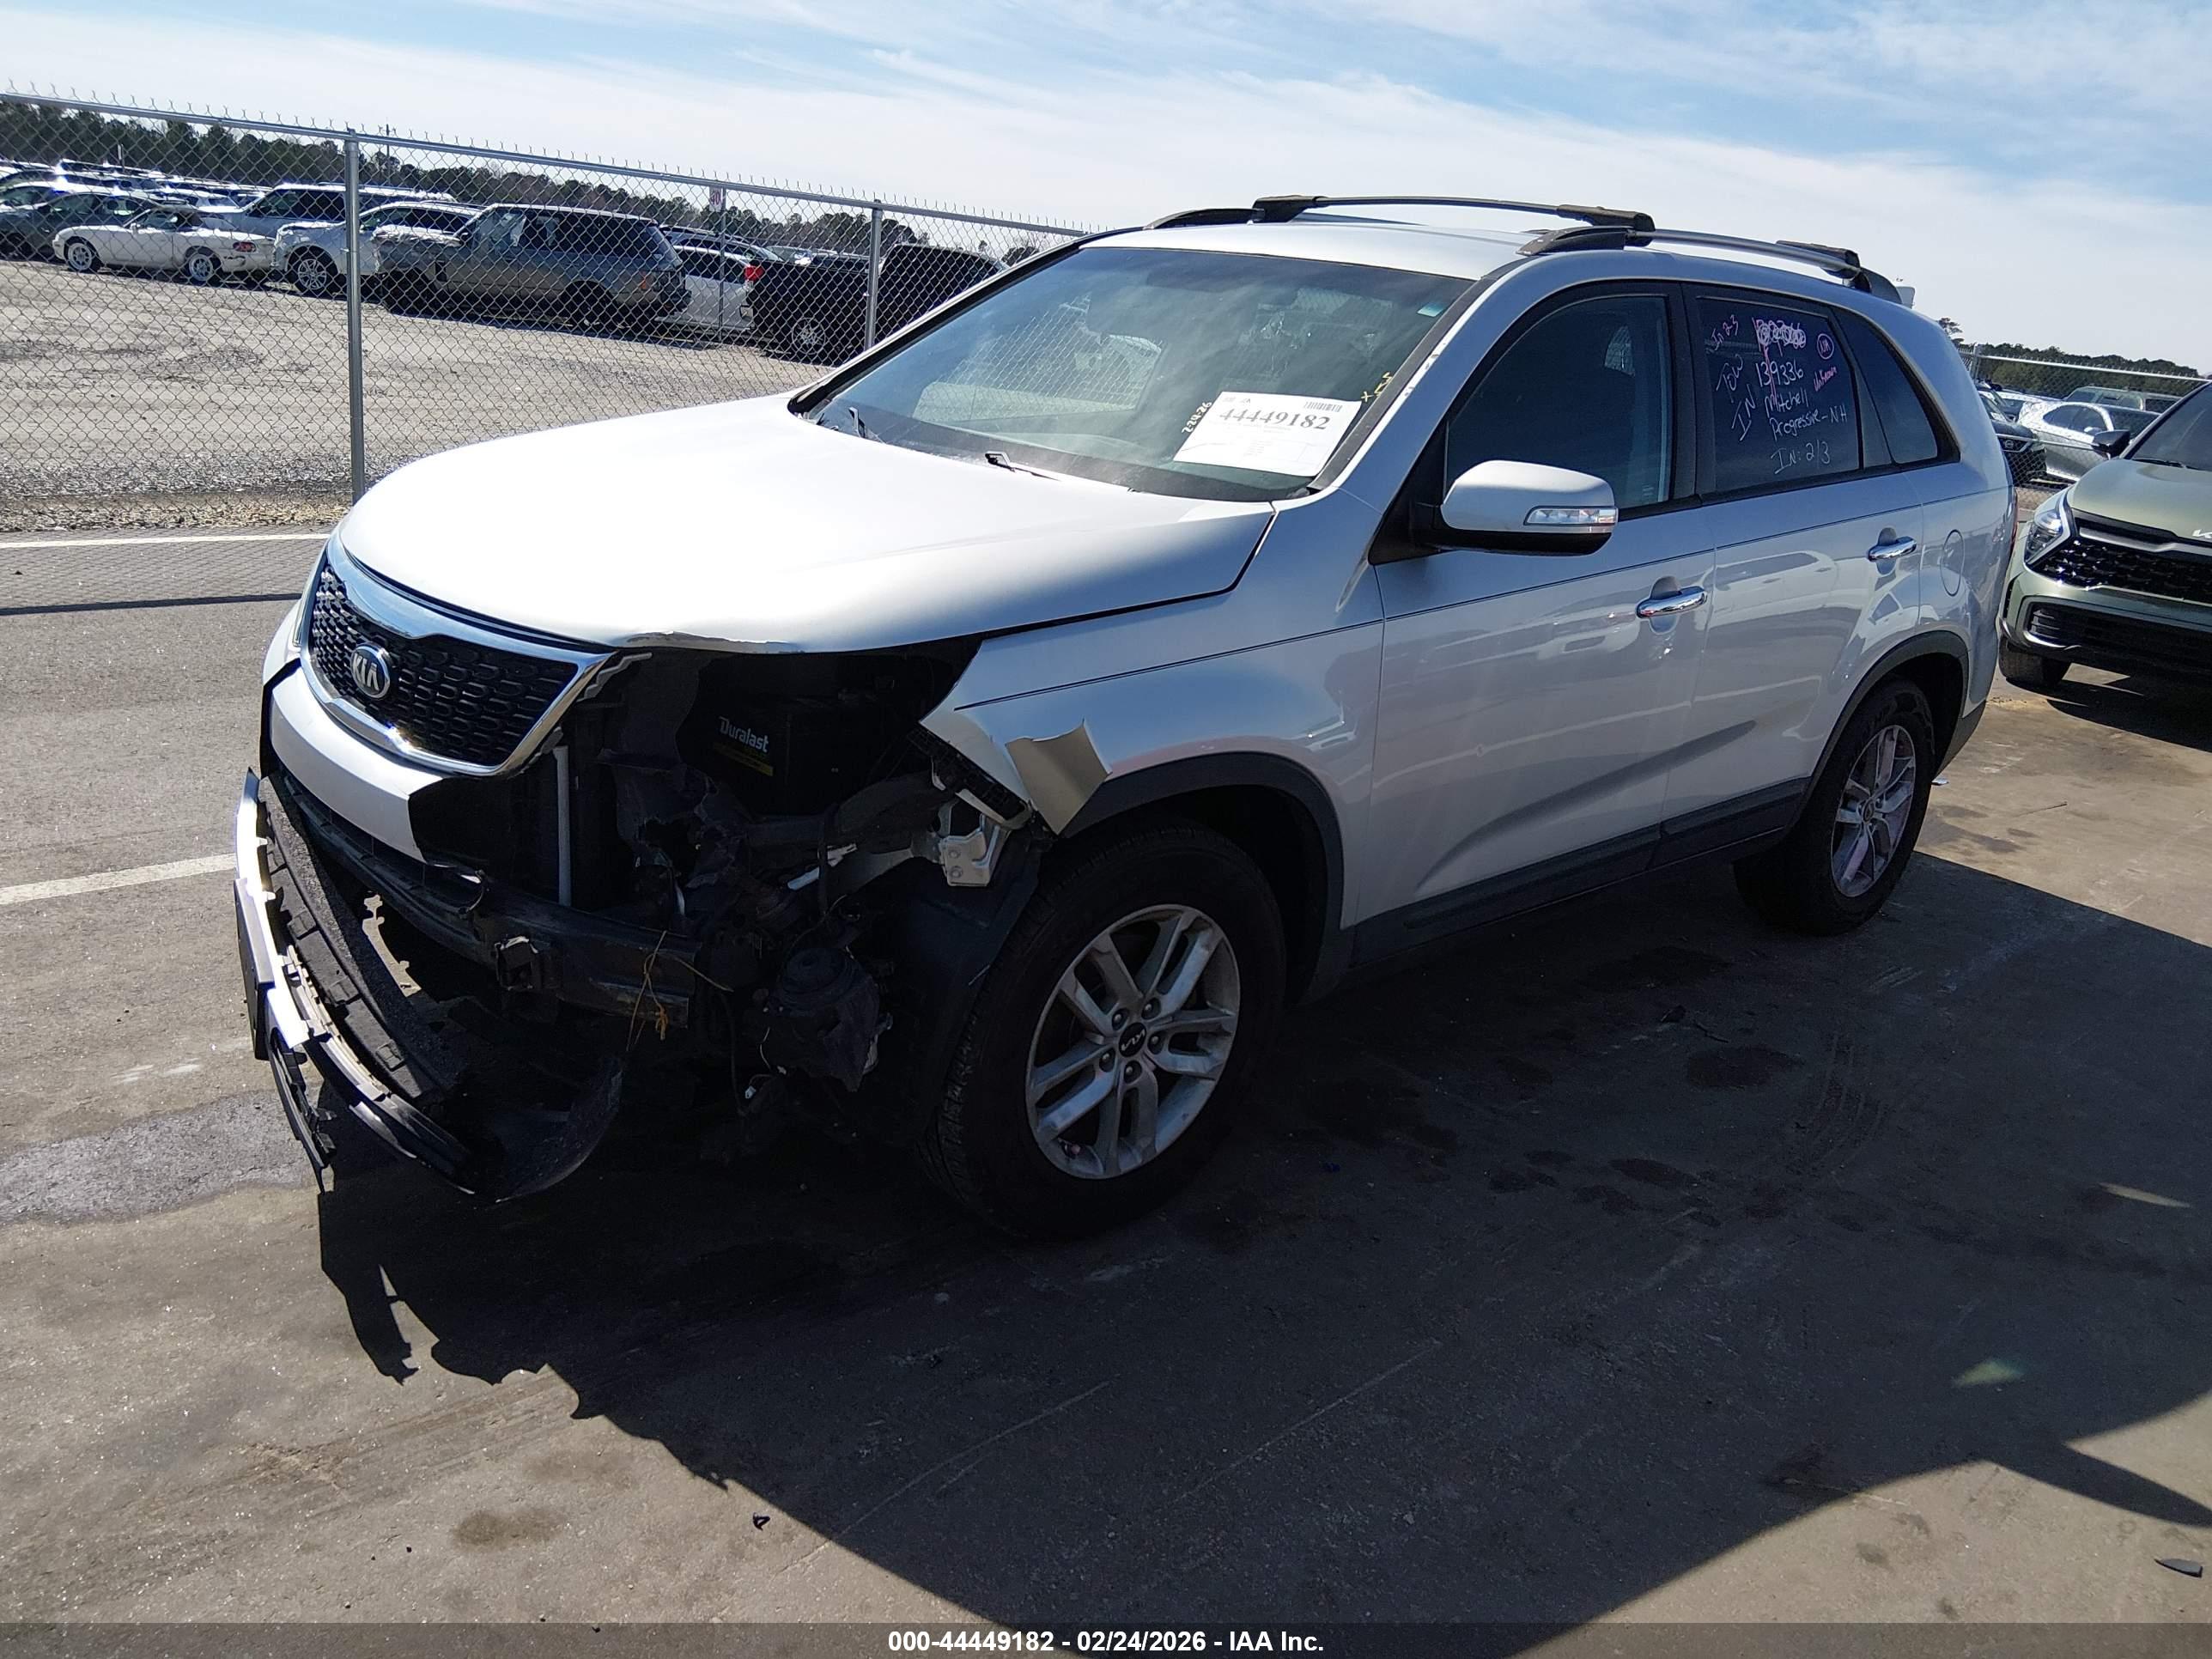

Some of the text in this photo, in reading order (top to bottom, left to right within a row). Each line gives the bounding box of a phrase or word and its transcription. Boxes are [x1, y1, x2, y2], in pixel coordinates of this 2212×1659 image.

[1755, 359, 1804, 387] 139336
[1219, 408, 1331, 430] 44449182
[352, 652, 380, 691] KIA
[718, 715, 769, 753] Duralast
